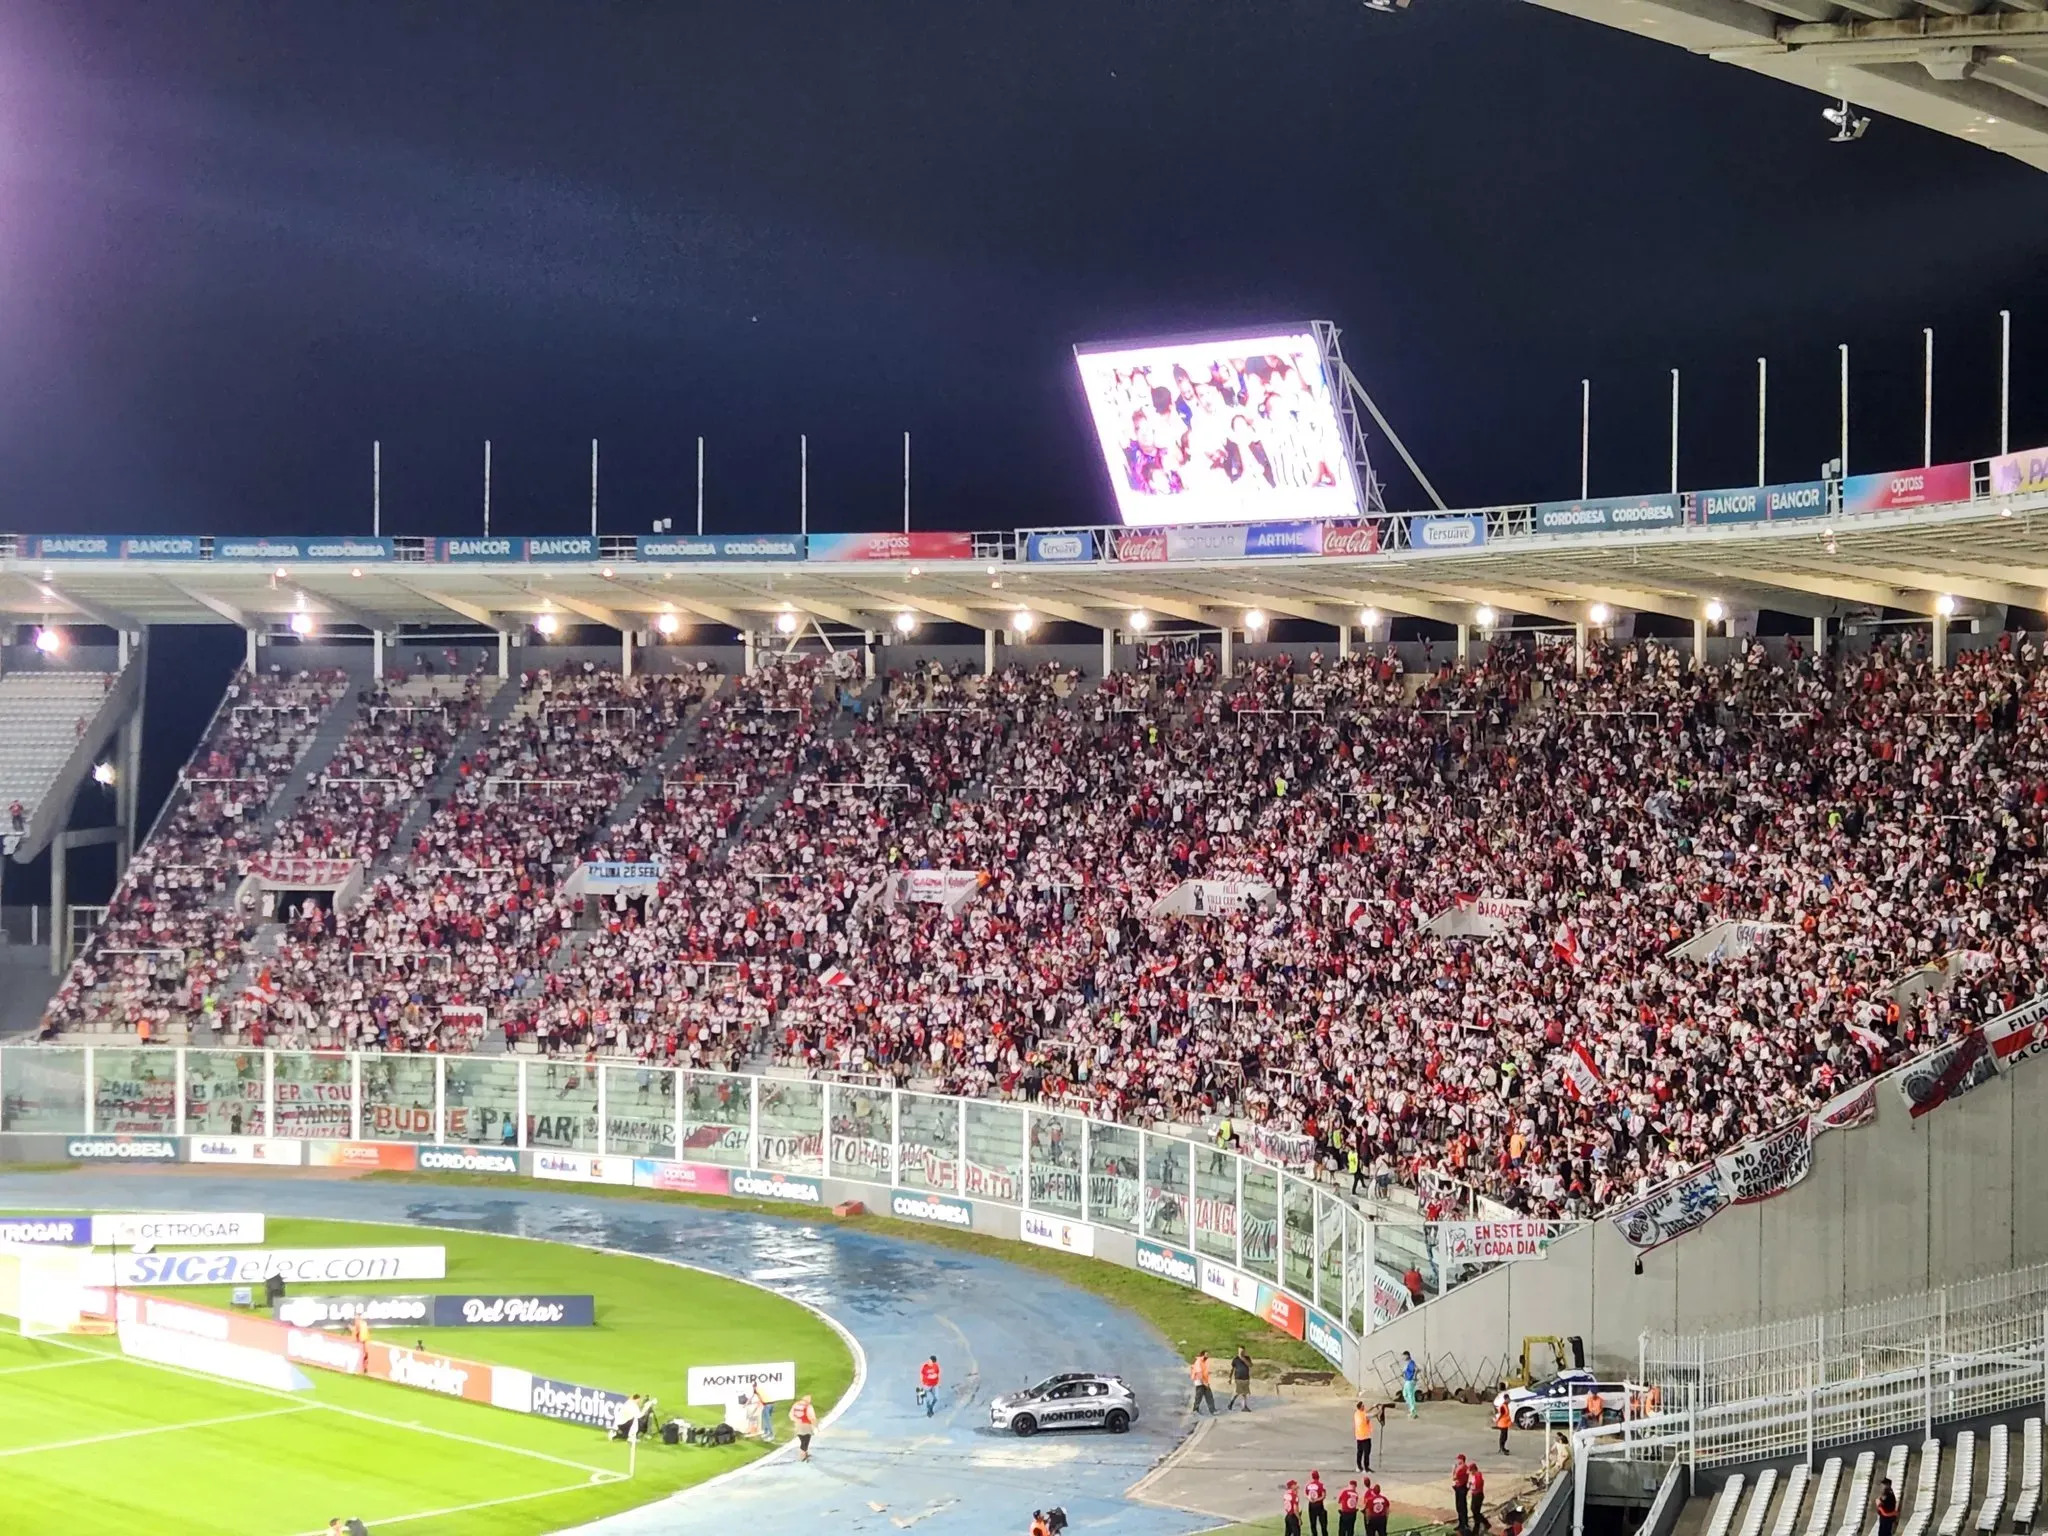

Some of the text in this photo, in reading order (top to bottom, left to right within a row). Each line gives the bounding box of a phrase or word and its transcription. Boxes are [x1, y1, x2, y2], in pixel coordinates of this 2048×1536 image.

[1892, 475, 1924, 496] opross
[1708, 496, 1756, 515] BANCOR
[1771, 489, 1820, 510] BANCOR
[1543, 505, 1674, 527] CORDOBESA CORDOBESA
[1428, 526, 1470, 541] Tersuave
[42, 540, 192, 553] BANCOR BANCOR
[450, 540, 592, 555] BANCOR BANCOR
[644, 543, 796, 555] CORDOBESA CORDOBESA
[868, 537, 909, 551] opross
[247, 1081, 301, 1100] RIER
[68, 1141, 175, 1158] CORDOBESA
[1735, 1126, 1803, 1170] NO PUEDO
[421, 1151, 517, 1173] CORDOBESA
[1732, 1159, 1780, 1184] PARAR
[734, 1176, 819, 1202] CORDOBESA
[1048, 1172, 1113, 1206] FERNNDO
[1645, 1193, 1673, 1217] QUE
[1677, 1178, 1702, 1195] ME
[893, 1197, 970, 1226] CORDOBESA
[141, 1223, 240, 1239] CETROGAR
[1475, 1222, 1547, 1241] EN ESTE DIA
[1474, 1240, 1536, 1257] Y CADA DIA
[1137, 1247, 1196, 1284] CORDOBESA
[463, 1298, 564, 1323] Del Pilar
[703, 1372, 783, 1387] MONTIRONI
[1041, 1408, 1105, 1423] MONTIRONI
